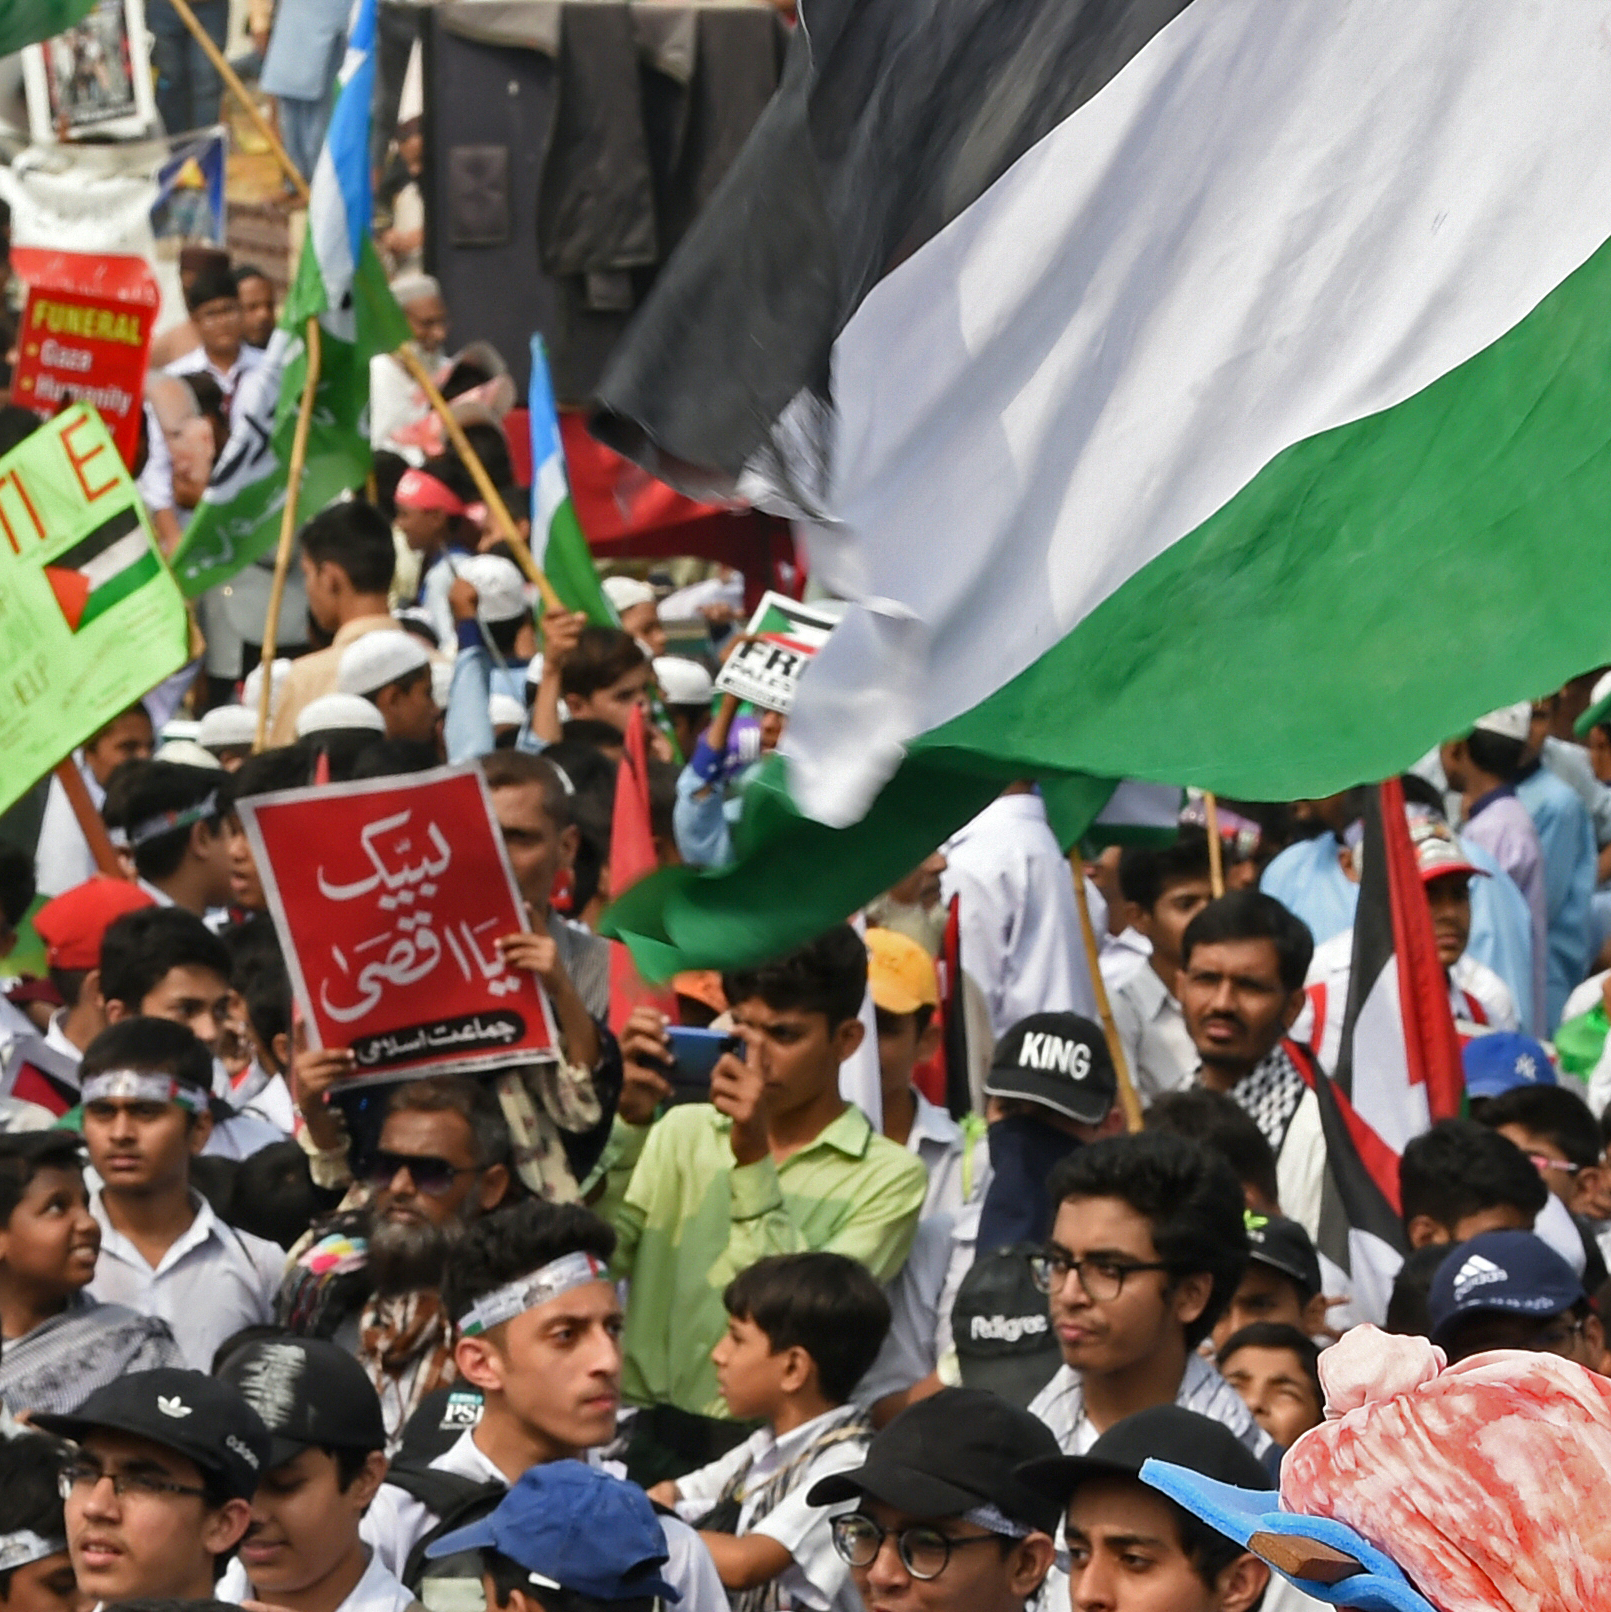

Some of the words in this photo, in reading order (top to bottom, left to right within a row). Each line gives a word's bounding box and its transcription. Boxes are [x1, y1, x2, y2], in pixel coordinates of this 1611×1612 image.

[31, 298, 142, 347] FUNERAL
[428, 1016, 517, 1046] جماعت
[1019, 1031, 1092, 1080] KING
